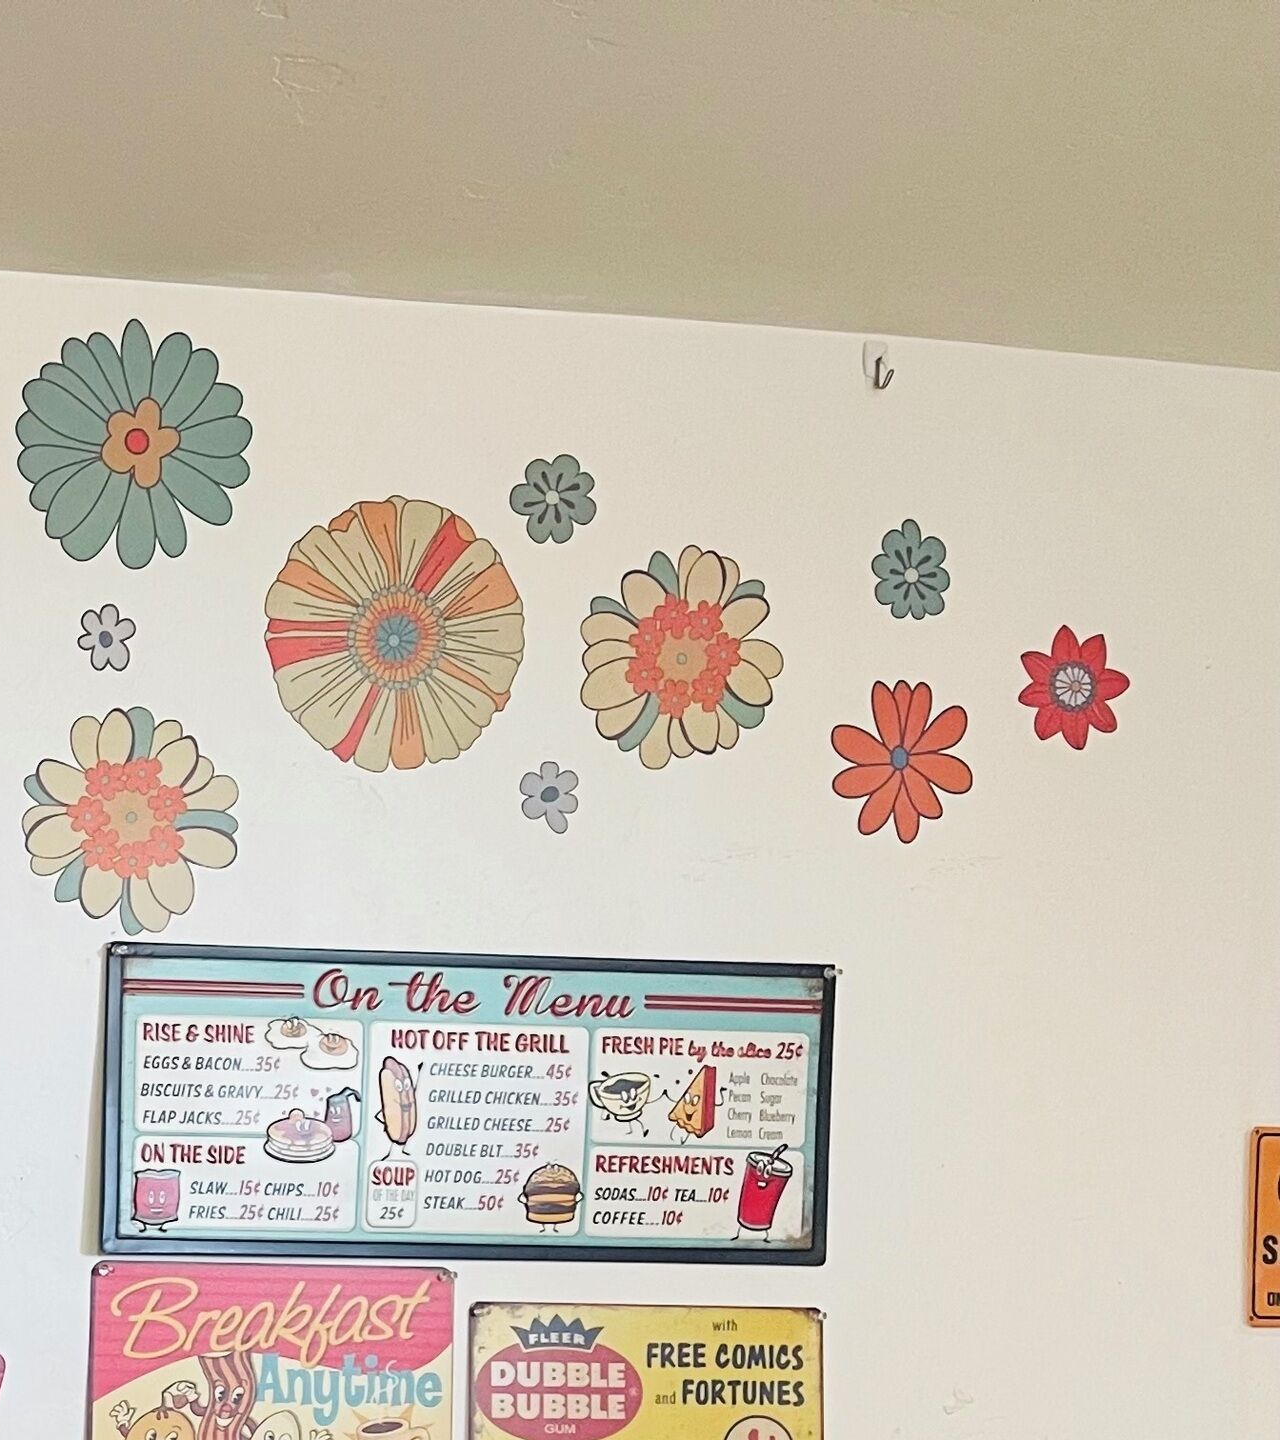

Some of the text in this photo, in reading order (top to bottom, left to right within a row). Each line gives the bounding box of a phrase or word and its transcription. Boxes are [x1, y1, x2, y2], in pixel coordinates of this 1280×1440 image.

[313, 968, 636, 1019] On the Menu
[143, 1022, 254, 1043] RISE & SHINE
[392, 1029, 570, 1053] HOT OFF THE GRILL
[602, 1036, 654, 1055] FRESH
[660, 1037, 684, 1056] PIE
[689, 1041, 708, 1062] by
[711, 1041, 733, 1057] the
[777, 1042, 803, 1059] 25¢
[143, 1056, 179, 1069] EGGS
[182, 1056, 192, 1069] &
[430, 1063, 477, 1077] CHEESE
[729, 1073, 798, 1086] Apple Chocolate
[141, 1083, 201, 1098] BISCUITS
[204, 1085, 214, 1097] &
[429, 1090, 481, 1104] GRILLED
[760, 1093, 783, 1106] Sugar
[142, 1111, 176, 1124] FLAP
[428, 1116, 480, 1130] GRILLED
[728, 1109, 795, 1124] Cherry Blueberry
[727, 1127, 783, 1140] Lemon Cream
[141, 1142, 245, 1164] ON THE SIDE
[426, 1143, 476, 1157] DOUBLE
[595, 1155, 734, 1175] REFRESHMENTS
[372, 1167, 415, 1186] SOUP
[425, 1170, 451, 1183] HOT
[380, 1207, 404, 1220] 25¢
[111, 1277, 431, 1367] Breakfast
[712, 1320, 738, 1332] with
[528, 1332, 586, 1346] FLEER
[647, 1343, 804, 1370] FREE COMICS
[491, 1361, 626, 1388] DUBBLE
[255, 1353, 442, 1426] Anytime
[655, 1380, 804, 1407] and FORTUNES
[491, 1393, 626, 1419] BUBBLE
[544, 1423, 576, 1434] GUM
